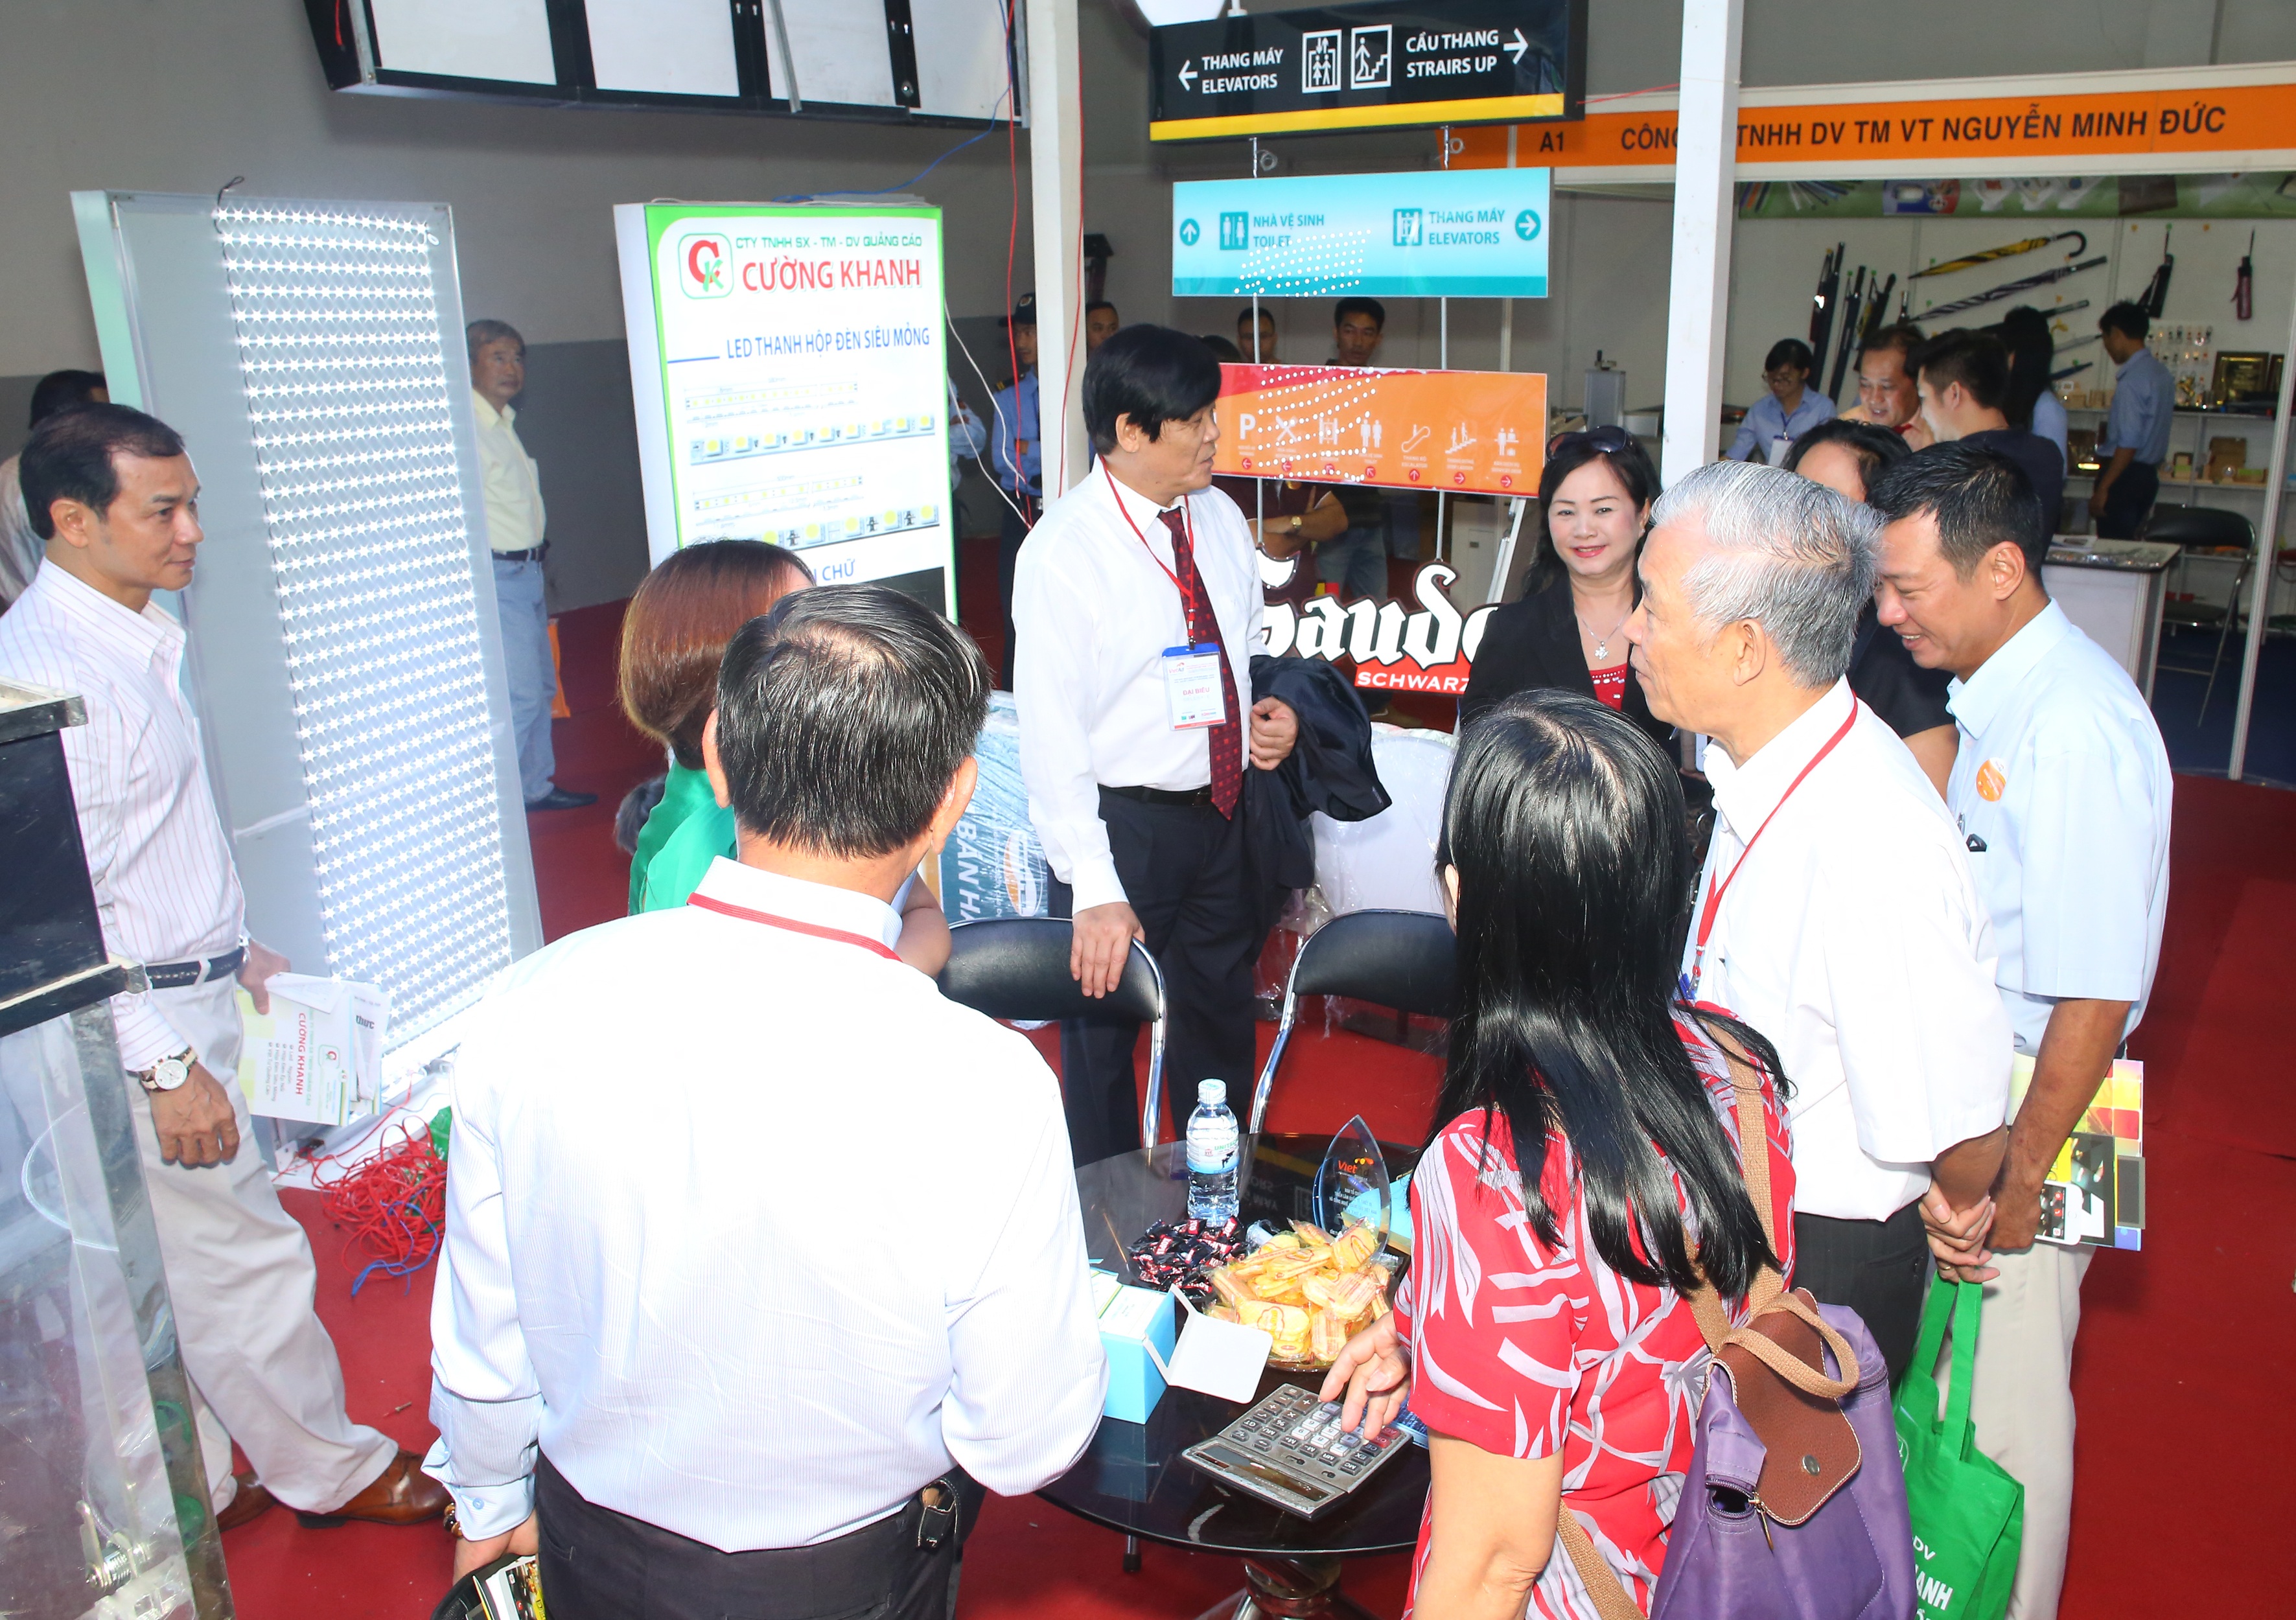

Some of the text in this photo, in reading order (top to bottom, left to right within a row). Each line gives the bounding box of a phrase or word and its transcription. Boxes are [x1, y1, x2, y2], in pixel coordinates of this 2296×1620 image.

[1406, 29, 1499, 53] CẦU THANG
[1202, 47, 1283, 71] THANG MÁY
[1407, 56, 1497, 78] STRAIRS UP
[1202, 73, 1277, 94] ELEVATORS
[1737, 123, 1801, 147] TNHH
[1811, 122, 1846, 145] DV
[1854, 119, 1890, 143] TM
[1900, 119, 1934, 142] VT
[1942, 103, 2061, 142] NGUYỄN
[2072, 111, 2148, 138] MINH
[2160, 101, 2227, 135] ĐỨC
[1540, 132, 1564, 152] A1
[1253, 213, 1325, 230] NHÀ VỆ SINH
[1429, 207, 1505, 224] THANG MÁY
[736, 237, 757, 249] CTY
[761, 237, 792, 248] TNHH
[796, 237, 810, 248] SX
[820, 237, 836, 248] TM
[846, 237, 860, 247] DV
[863, 231, 898, 247] QUẢNG
[902, 233, 922, 247] CÁO
[1429, 232, 1500, 245] ELEVATORS
[743, 255, 921, 292] CƯỜNG KHANH
[727, 322, 929, 358] LED THANH HỘP ĐÈN SIÊU MỎNG
[823, 559, 855, 581] CHỮ
[296, 1013, 308, 1095] CƯỜNG KHANH
